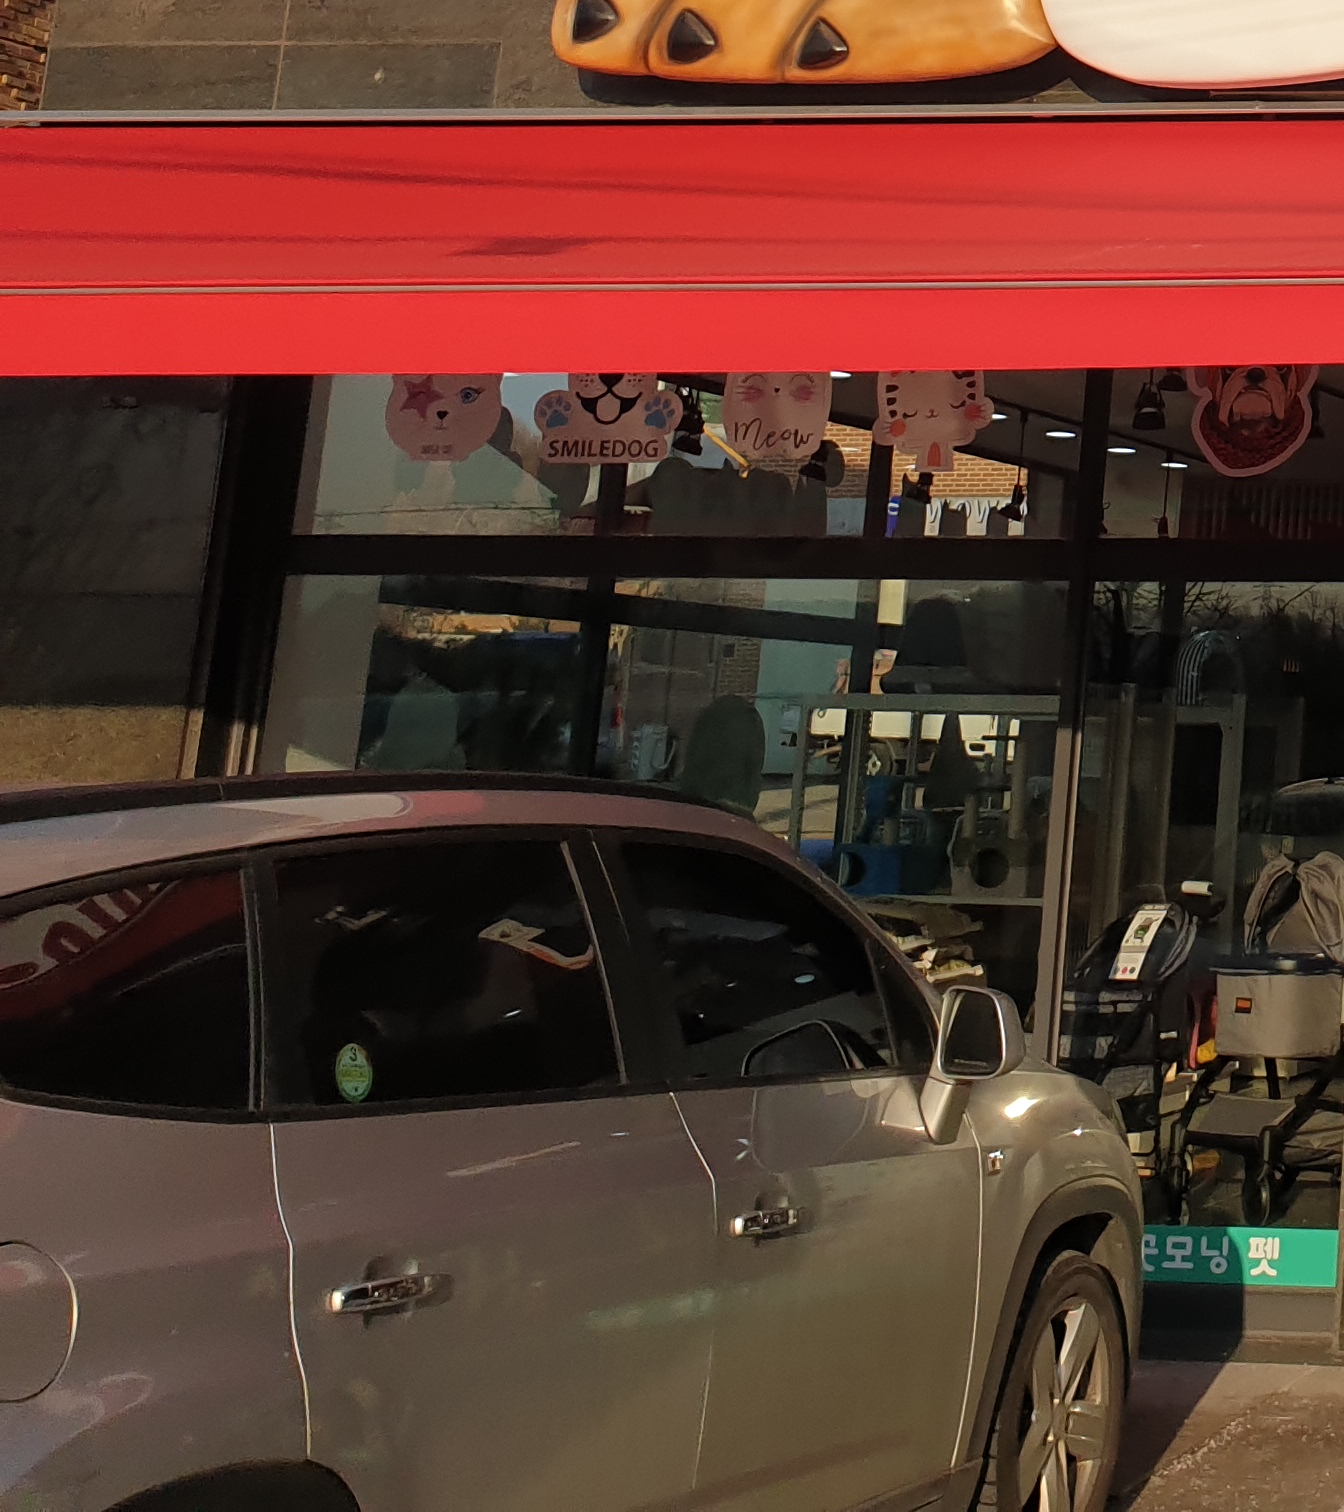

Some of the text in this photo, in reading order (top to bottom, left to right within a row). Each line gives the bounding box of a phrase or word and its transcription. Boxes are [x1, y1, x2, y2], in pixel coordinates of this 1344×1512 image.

[545, 437, 660, 460] SMILEDOG
[733, 417, 815, 451] Meow
[1247, 1236, 1282, 1278] 펫
